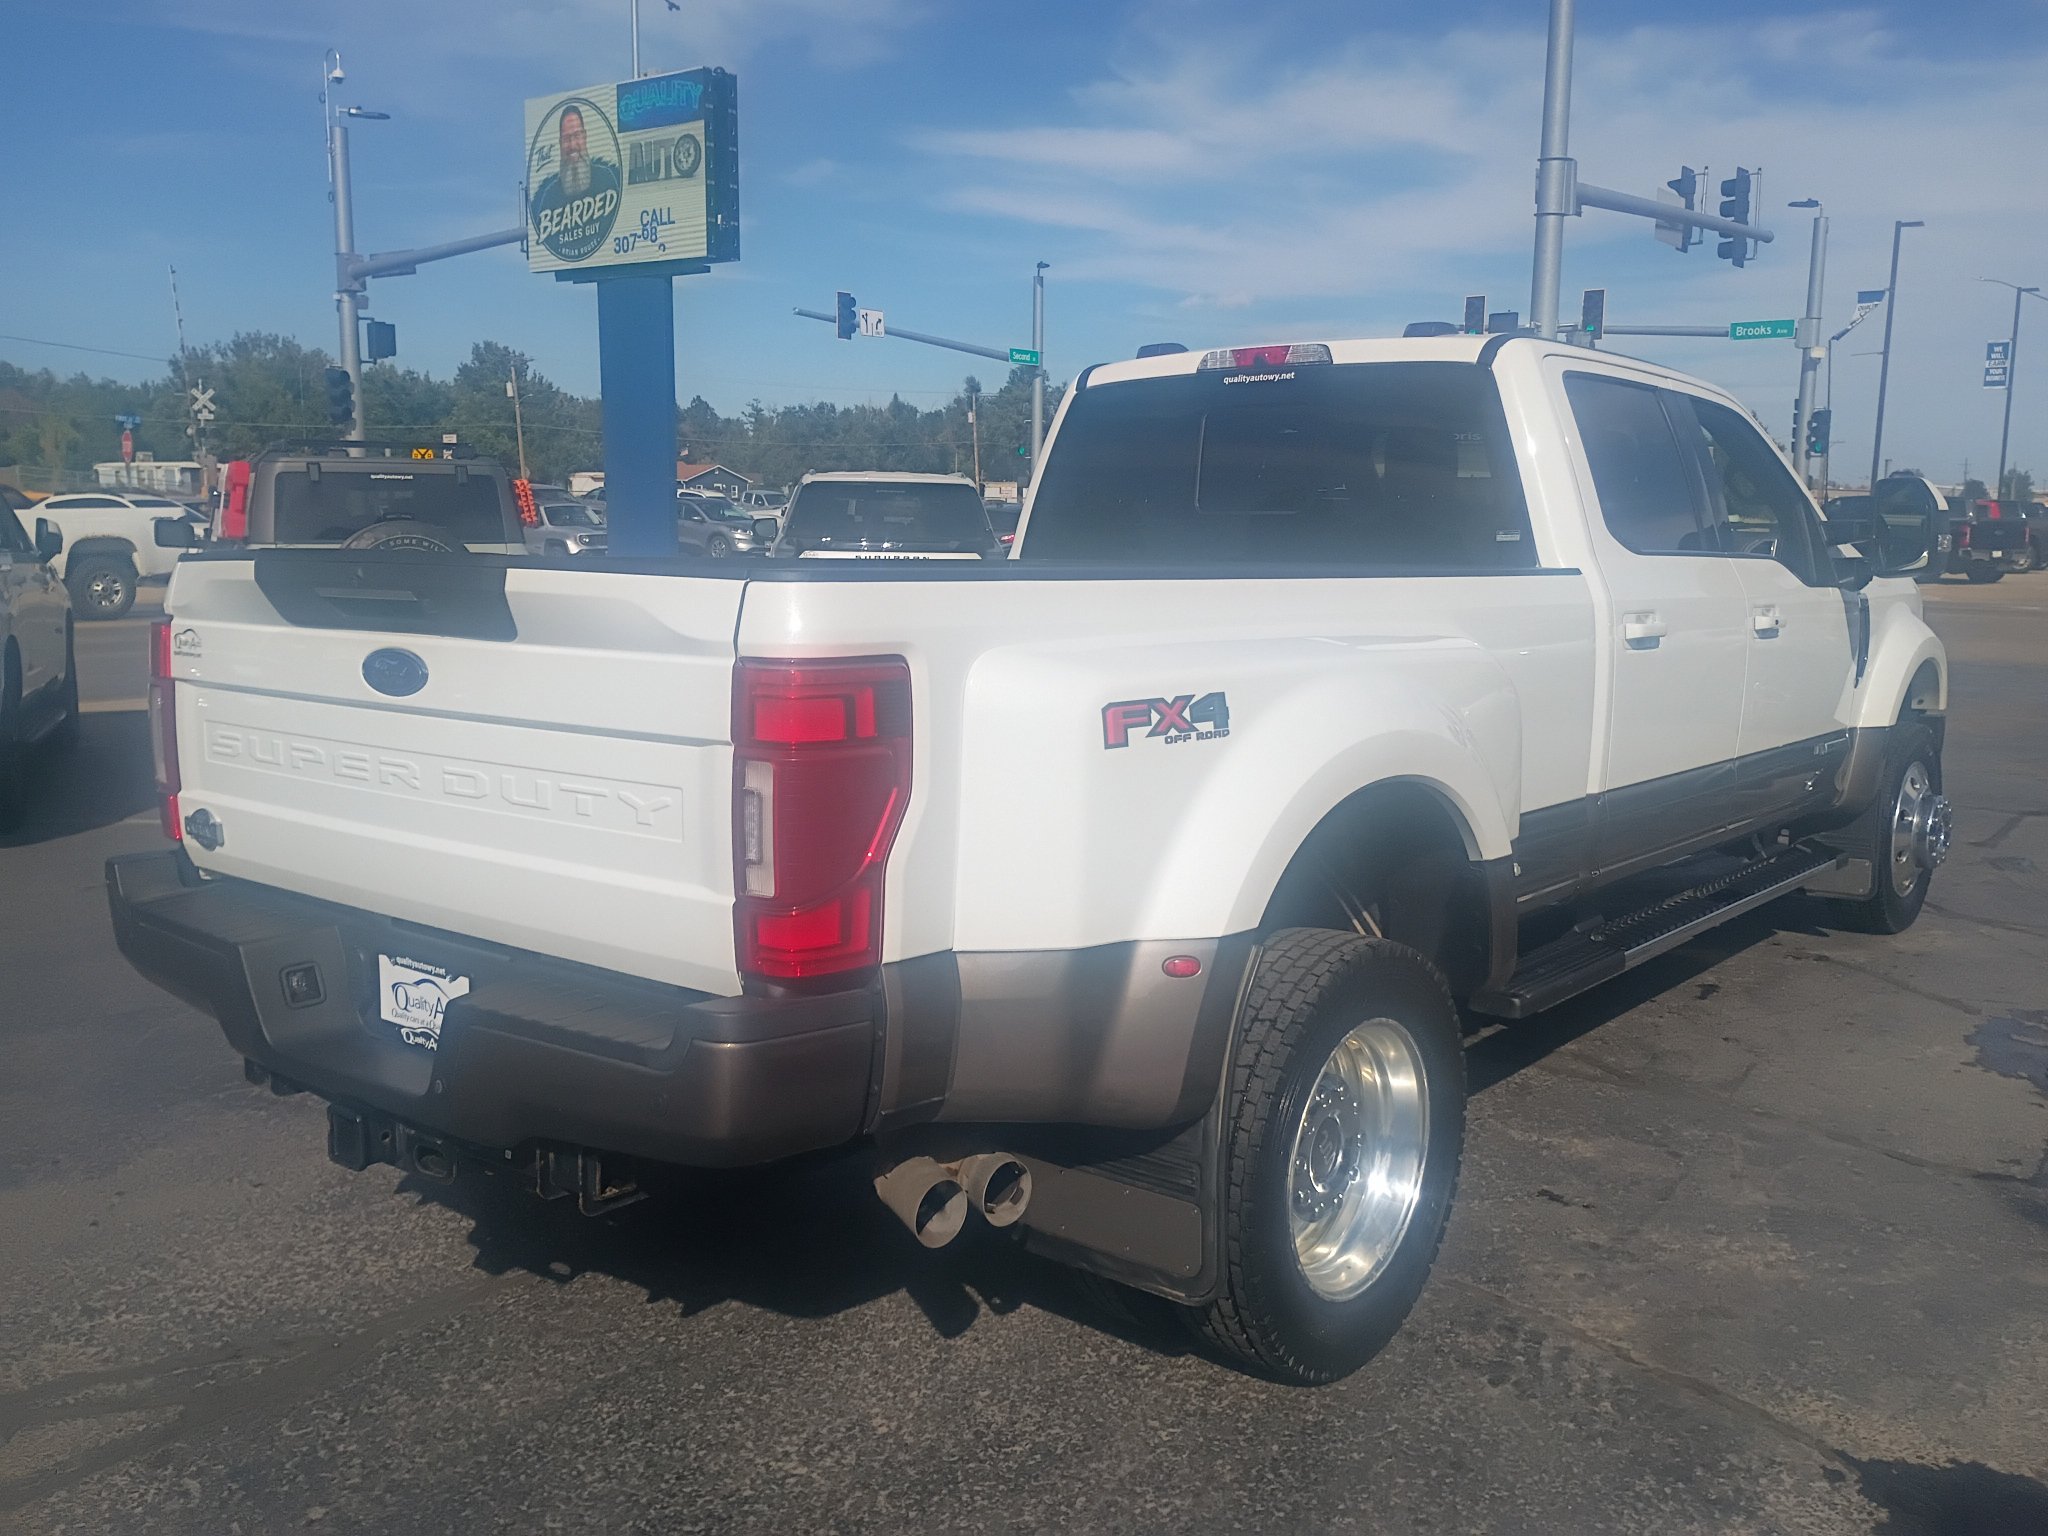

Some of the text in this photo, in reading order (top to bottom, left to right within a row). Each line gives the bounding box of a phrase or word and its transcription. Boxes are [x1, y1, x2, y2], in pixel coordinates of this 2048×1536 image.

[619, 80, 703, 120] QUALITY
[628, 133, 702, 185] AUTO
[538, 189, 618, 243] BEARDED
[640, 207, 675, 227] CALL
[559, 222, 600, 244] SALES GUY
[1736, 325, 1772, 336] Brooks
[1223, 371, 1295, 384] qualityautowy.net
[1101, 691, 1230, 750] FX4
[1164, 728, 1230, 745] OFF ROAD
[211, 731, 672, 826] SUPER DUTY
